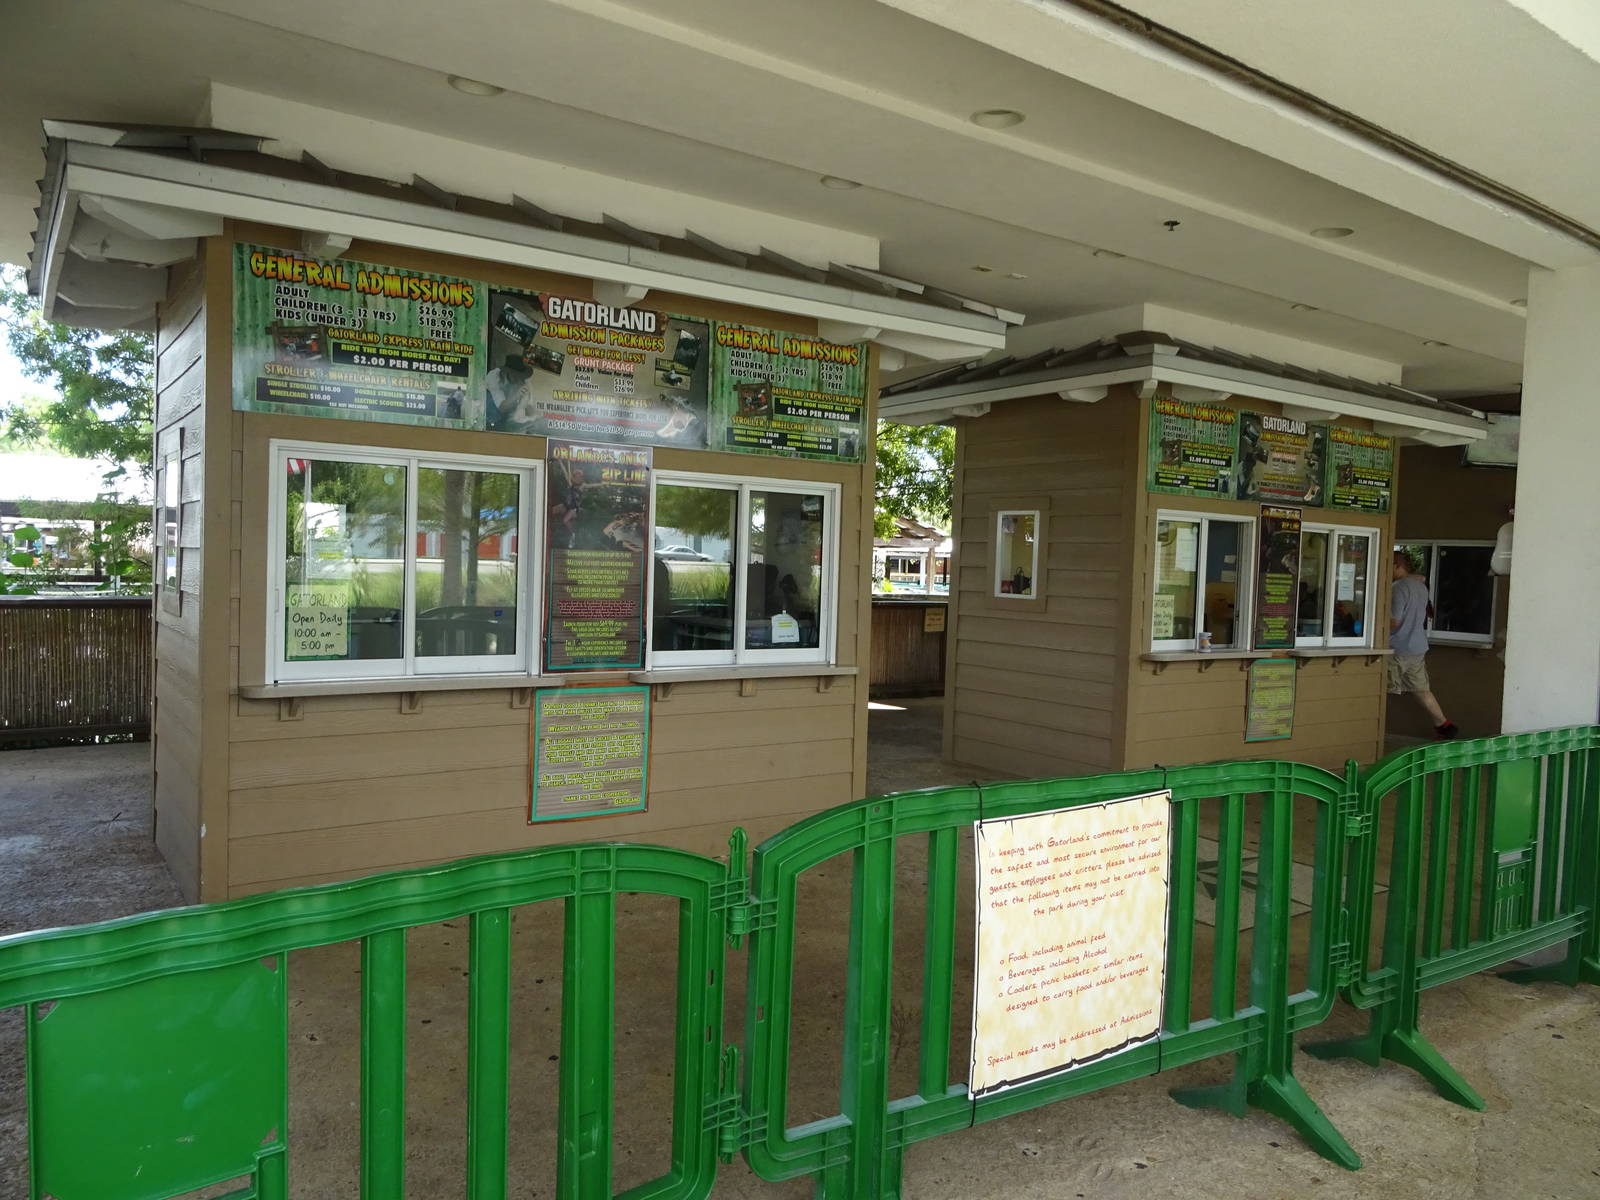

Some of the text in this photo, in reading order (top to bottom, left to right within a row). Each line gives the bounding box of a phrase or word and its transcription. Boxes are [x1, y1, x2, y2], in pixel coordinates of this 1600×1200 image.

[249, 251, 474, 309] GENERAL ADMISSIONS
[274, 297, 328, 313] CHILDREN
[331, 303, 343, 315] (3
[357, 308, 368, 318] 12
[372, 310, 397, 322] YRS)
[419, 317, 453, 330] $18.99
[275, 285, 454, 319] ADULT $26.99
[275, 308, 452, 340] KIDS (UNDER 3) FREE
[547, 296, 656, 334] GATORLAND
[327, 327, 475, 356] GATORLAND EXPRESS TRAIN RIDE
[541, 321, 666, 353] ADMISSION PACKAGES
[716, 325, 859, 367] GENERAL ADMISSIONS
[341, 343, 461, 365] RIDE THE IRON HORSE ALL DAY!
[353, 354, 453, 375] $2.00 PER PERSON
[567, 344, 646, 365] GET MORE FOR LESS!
[573, 356, 600, 369] GRUNT
[601, 361, 635, 374] PACKAGE
[730, 359, 764, 371] CHILDREN
[731, 350, 844, 374] ADULT $26.99
[264, 362, 317, 378] STROLLER
[390, 376, 432, 390] RENTALS
[574, 373, 591, 382] Adult
[574, 381, 600, 391] Children
[730, 368, 748, 377] KIDS
[749, 370, 775, 381] (UNDER
[787, 406, 850, 421] $2.00 PER PERSON
[1155, 400, 1236, 424] GENERAL ADMISSIONS
[1263, 415, 1307, 436] GATORLAND
[601, 466, 646, 481] ZIP LINE
[292, 611, 343, 626] Open Daily
[294, 628, 317, 638] 10:00
[301, 641, 335, 652] 5:00 pm
[998, 845, 1025, 858] keeping
[1028, 842, 1044, 852] with
[1046, 832, 1090, 848] Gatorland's
[1093, 826, 1130, 841] commitment
[1132, 823, 1140, 832] to
[1141, 819, 1163, 832] provide
[990, 835, 1162, 876] the safest and most secure environment for our
[1020, 874, 1056, 890] employees
[1058, 869, 1072, 878] and
[1105, 858, 1126, 873] please
[1138, 850, 1163, 862] advised
[991, 900, 1009, 909] that
[1012, 896, 1025, 905] the
[1028, 888, 1060, 905] following
[1062, 884, 1082, 894] items
[1084, 880, 1098, 891] may
[1100, 876, 1111, 886] not
[1113, 874, 1122, 882] be
[1124, 869, 1147, 881] carried
[1033, 907, 1046, 917] the
[1048, 903, 1064, 915] park
[1066, 897, 1090, 909] during
[1091, 894, 1108, 906] your
[1032, 944, 1064, 957] including
[1066, 937, 1088, 949] animal
[1090, 932, 1107, 945] feed
[1049, 954, 1081, 969] including
[1083, 946, 1108, 961] Alcohol
[1040, 977, 1060, 989] picnic
[1063, 968, 1090, 981] baskets
[1103, 958, 1125, 970] similar
[1126, 952, 1144, 963] items
[1005, 965, 1150, 1012] designed to carry food and/or beverages
[986, 1007, 1154, 1068] Special needs may be addressed at Admissions
